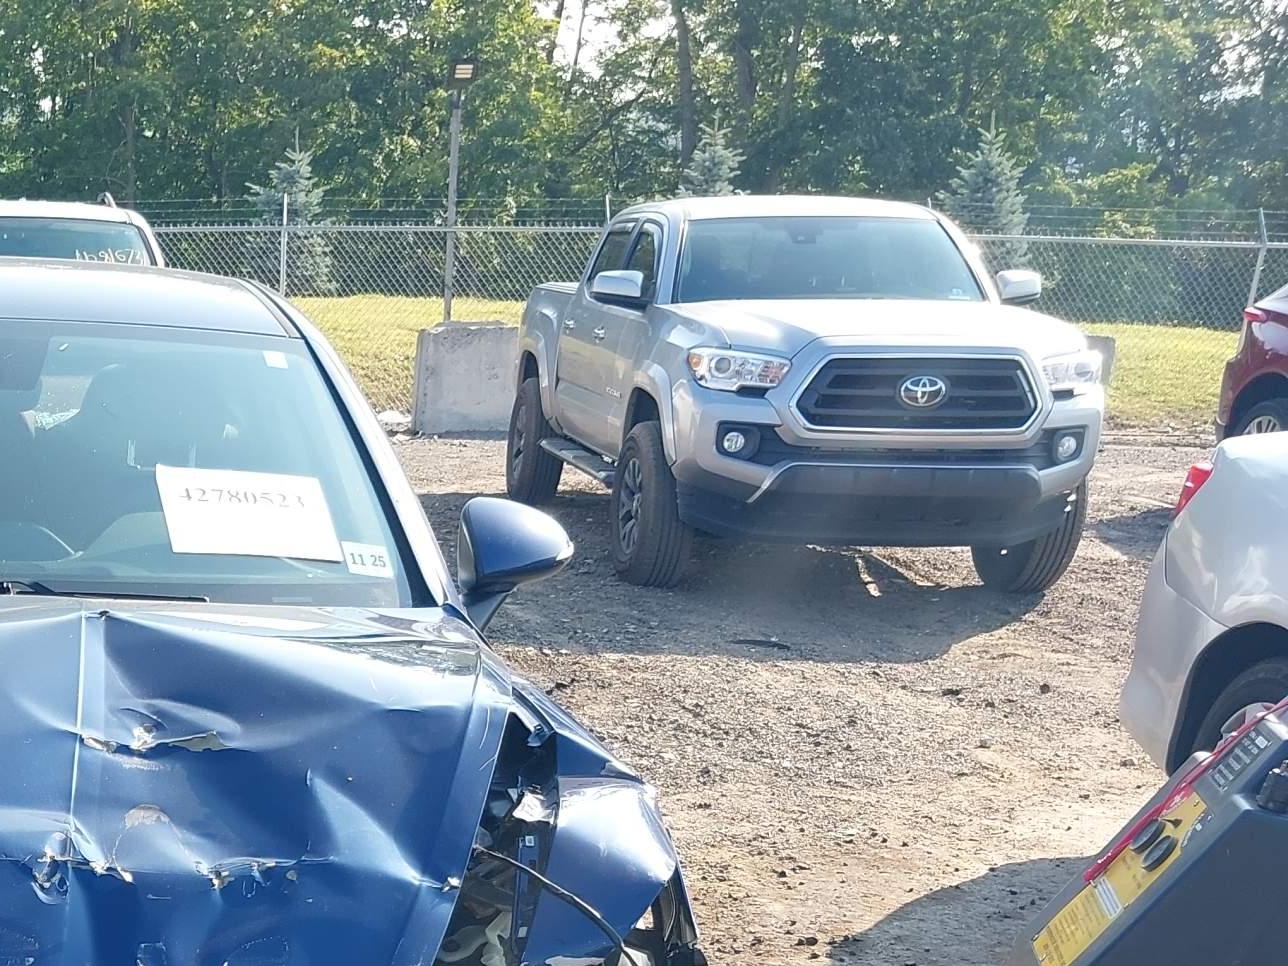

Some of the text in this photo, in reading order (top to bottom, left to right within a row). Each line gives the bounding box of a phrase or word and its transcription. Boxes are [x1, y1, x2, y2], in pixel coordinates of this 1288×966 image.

[179, 487, 306, 508] 42780523
[350, 552, 388, 568] 11 25
